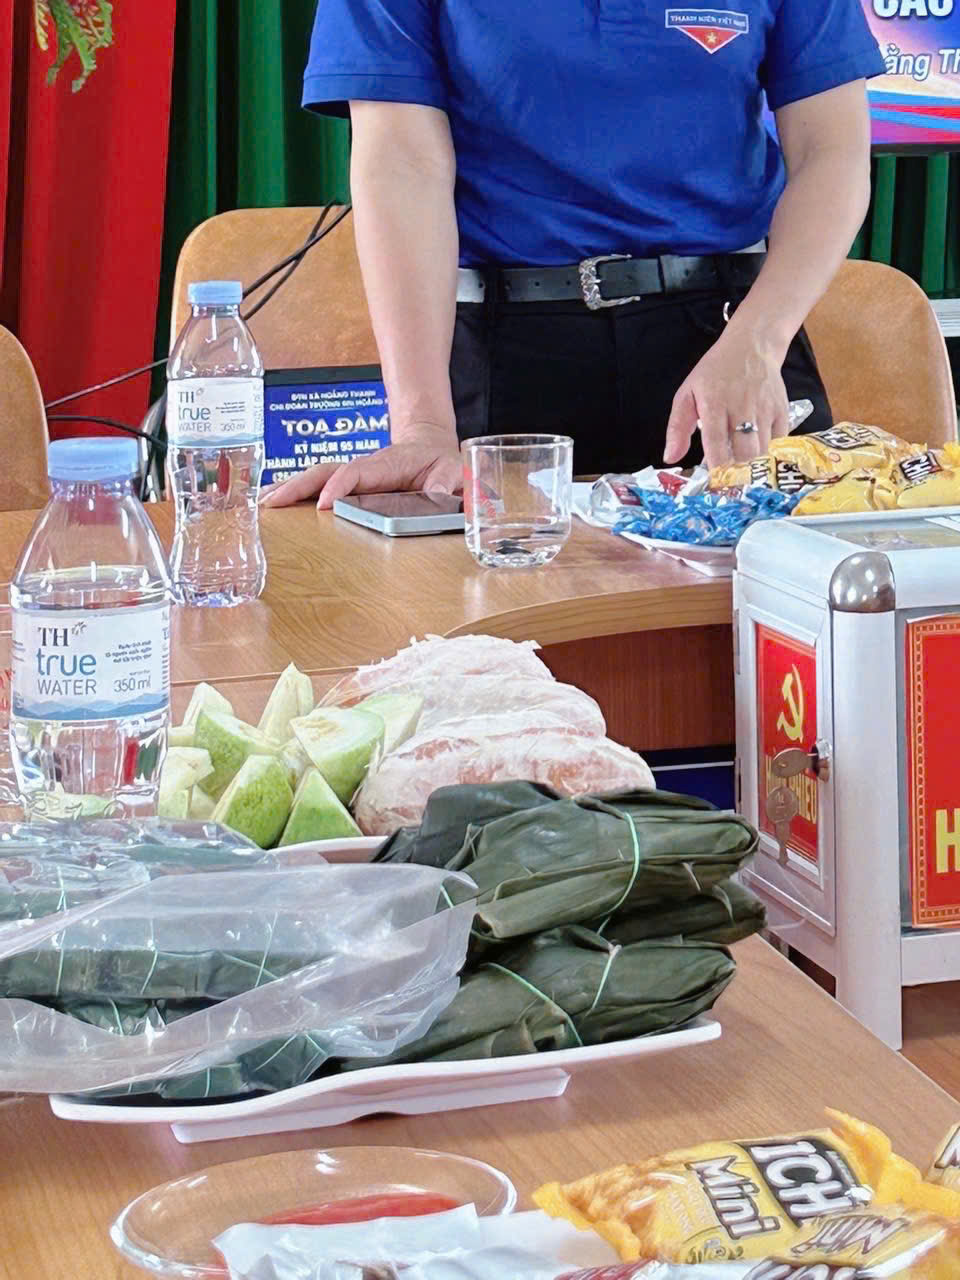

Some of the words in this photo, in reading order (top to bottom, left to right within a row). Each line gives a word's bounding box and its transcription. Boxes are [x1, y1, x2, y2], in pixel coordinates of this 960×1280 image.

[37, 627, 69, 647] TH
[36, 648, 97, 676] true
[37, 679, 97, 695] WATER
[114, 677, 136, 693] 350
[684, 1155, 781, 1240] Mini
